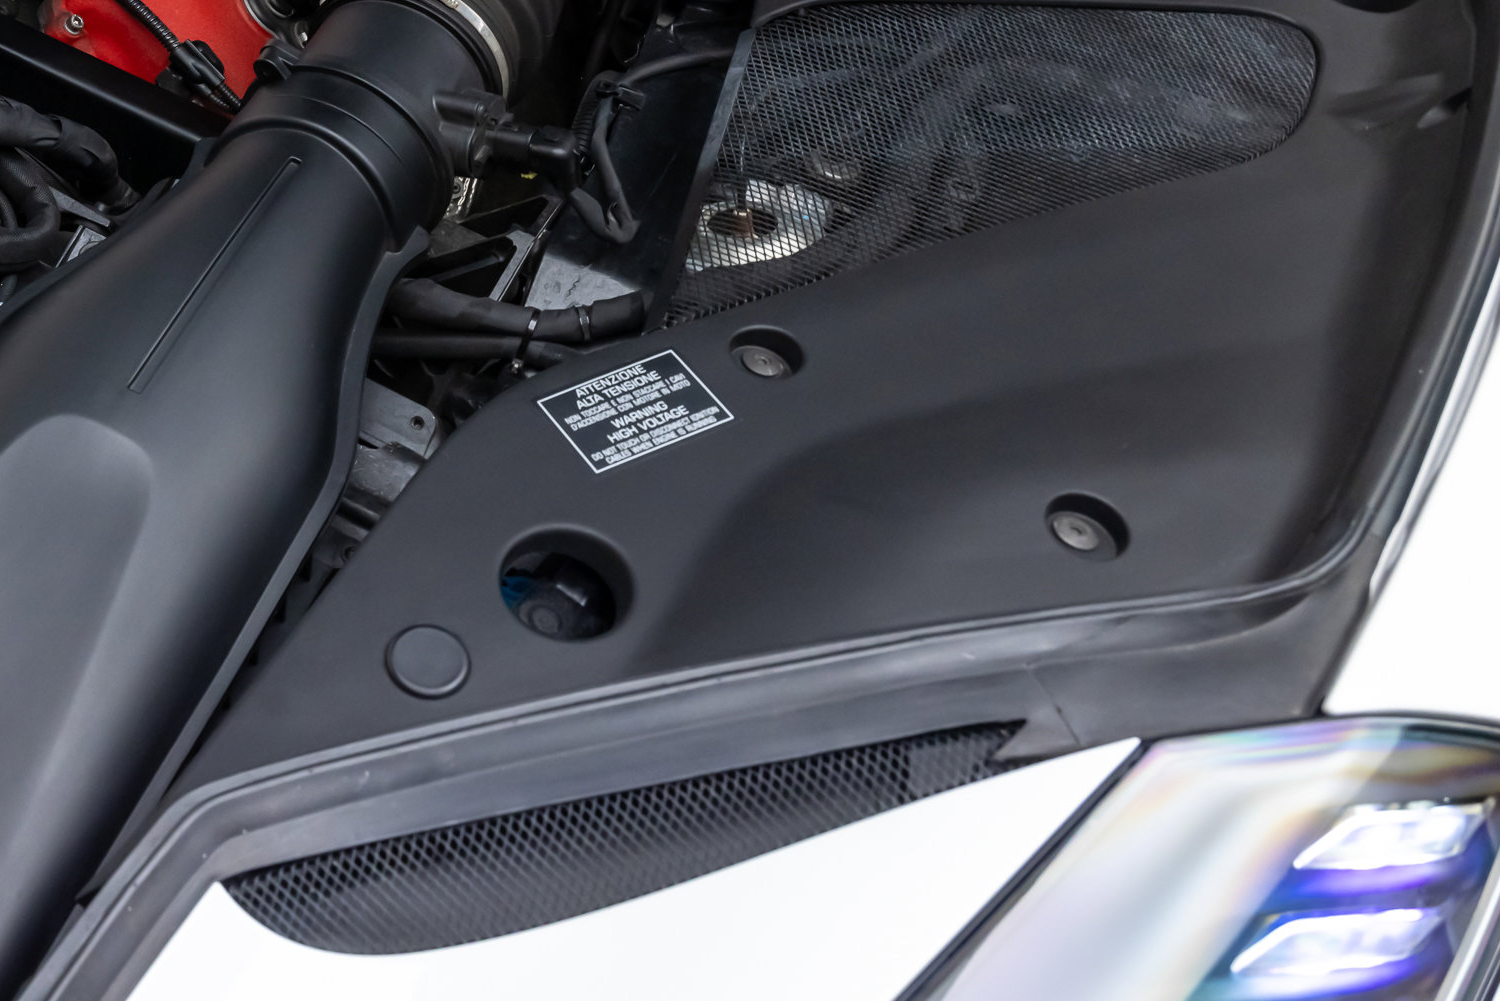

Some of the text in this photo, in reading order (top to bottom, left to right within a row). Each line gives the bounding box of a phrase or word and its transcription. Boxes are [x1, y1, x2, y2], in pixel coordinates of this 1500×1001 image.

[564, 413, 582, 425] NON
[581, 402, 612, 418] TOCCARE
[611, 399, 618, 407] E
[616, 394, 634, 404] NON
[632, 381, 667, 398] STACCARE
[669, 373, 687, 384] CAVI
[574, 364, 648, 398] ATTENZIONE
[574, 370, 663, 410] ALTA TENSIONE
[617, 402, 635, 413] CON
[633, 391, 662, 406] MOTORE
[661, 387, 671, 396] IN
[669, 379, 692, 392] MOTO
[607, 405, 690, 443] HIGH VOLTAGE
[611, 400, 670, 429] WARNING
[592, 452, 605, 462] DO
[603, 446, 619, 457] NOT
[617, 437, 641, 451] TOUCH
[639, 433, 652, 442] OR
[650, 417, 692, 438] DISCONNECT
[631, 441, 654, 454] WHEN
[677, 427, 687, 435] IS
